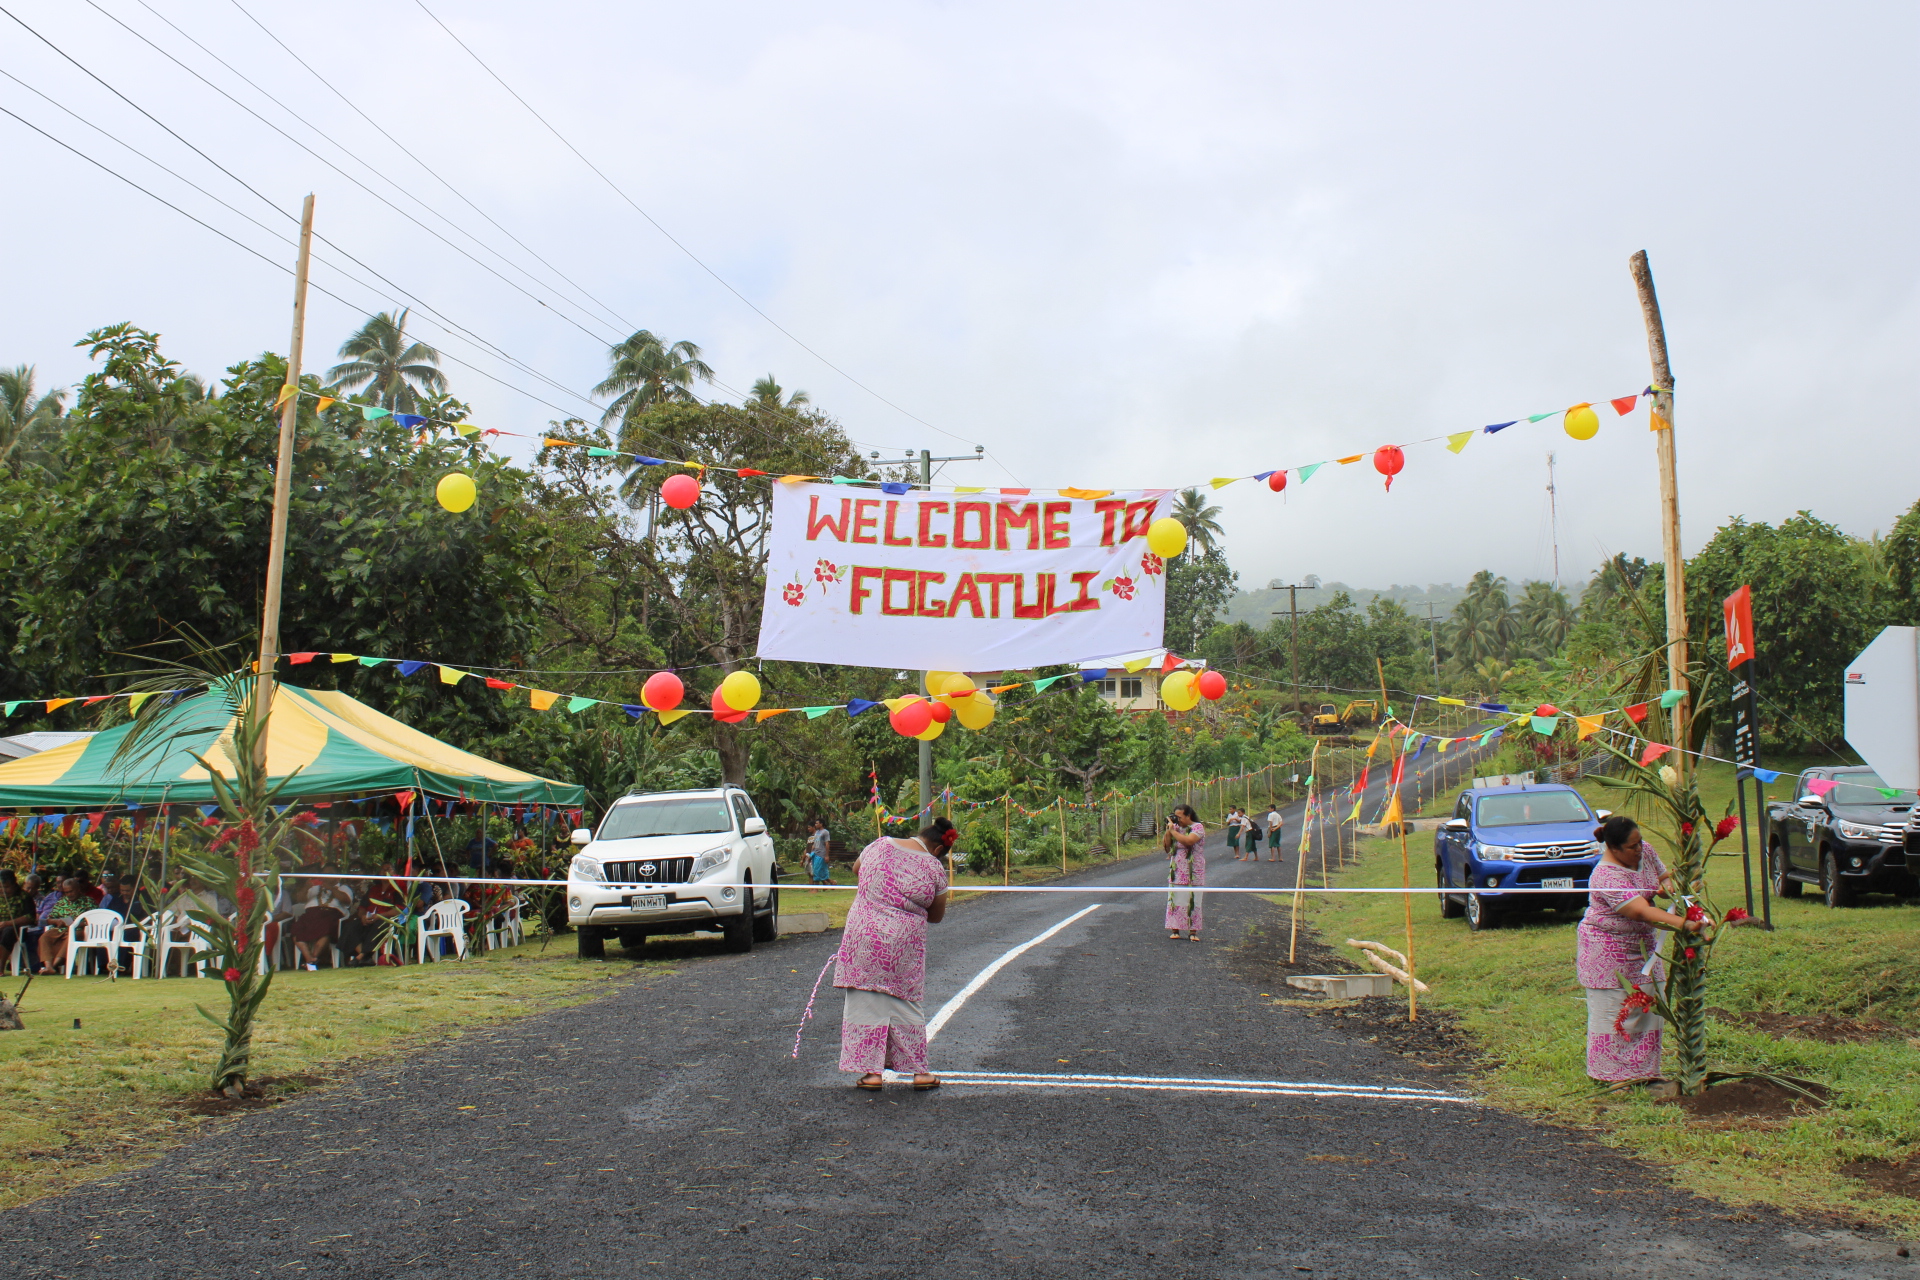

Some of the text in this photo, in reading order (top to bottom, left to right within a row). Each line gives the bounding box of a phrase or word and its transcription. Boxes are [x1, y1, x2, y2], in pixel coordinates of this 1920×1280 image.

[806, 495, 1158, 550] WELCOME TO
[848, 564, 1101, 619] FOGATULI
